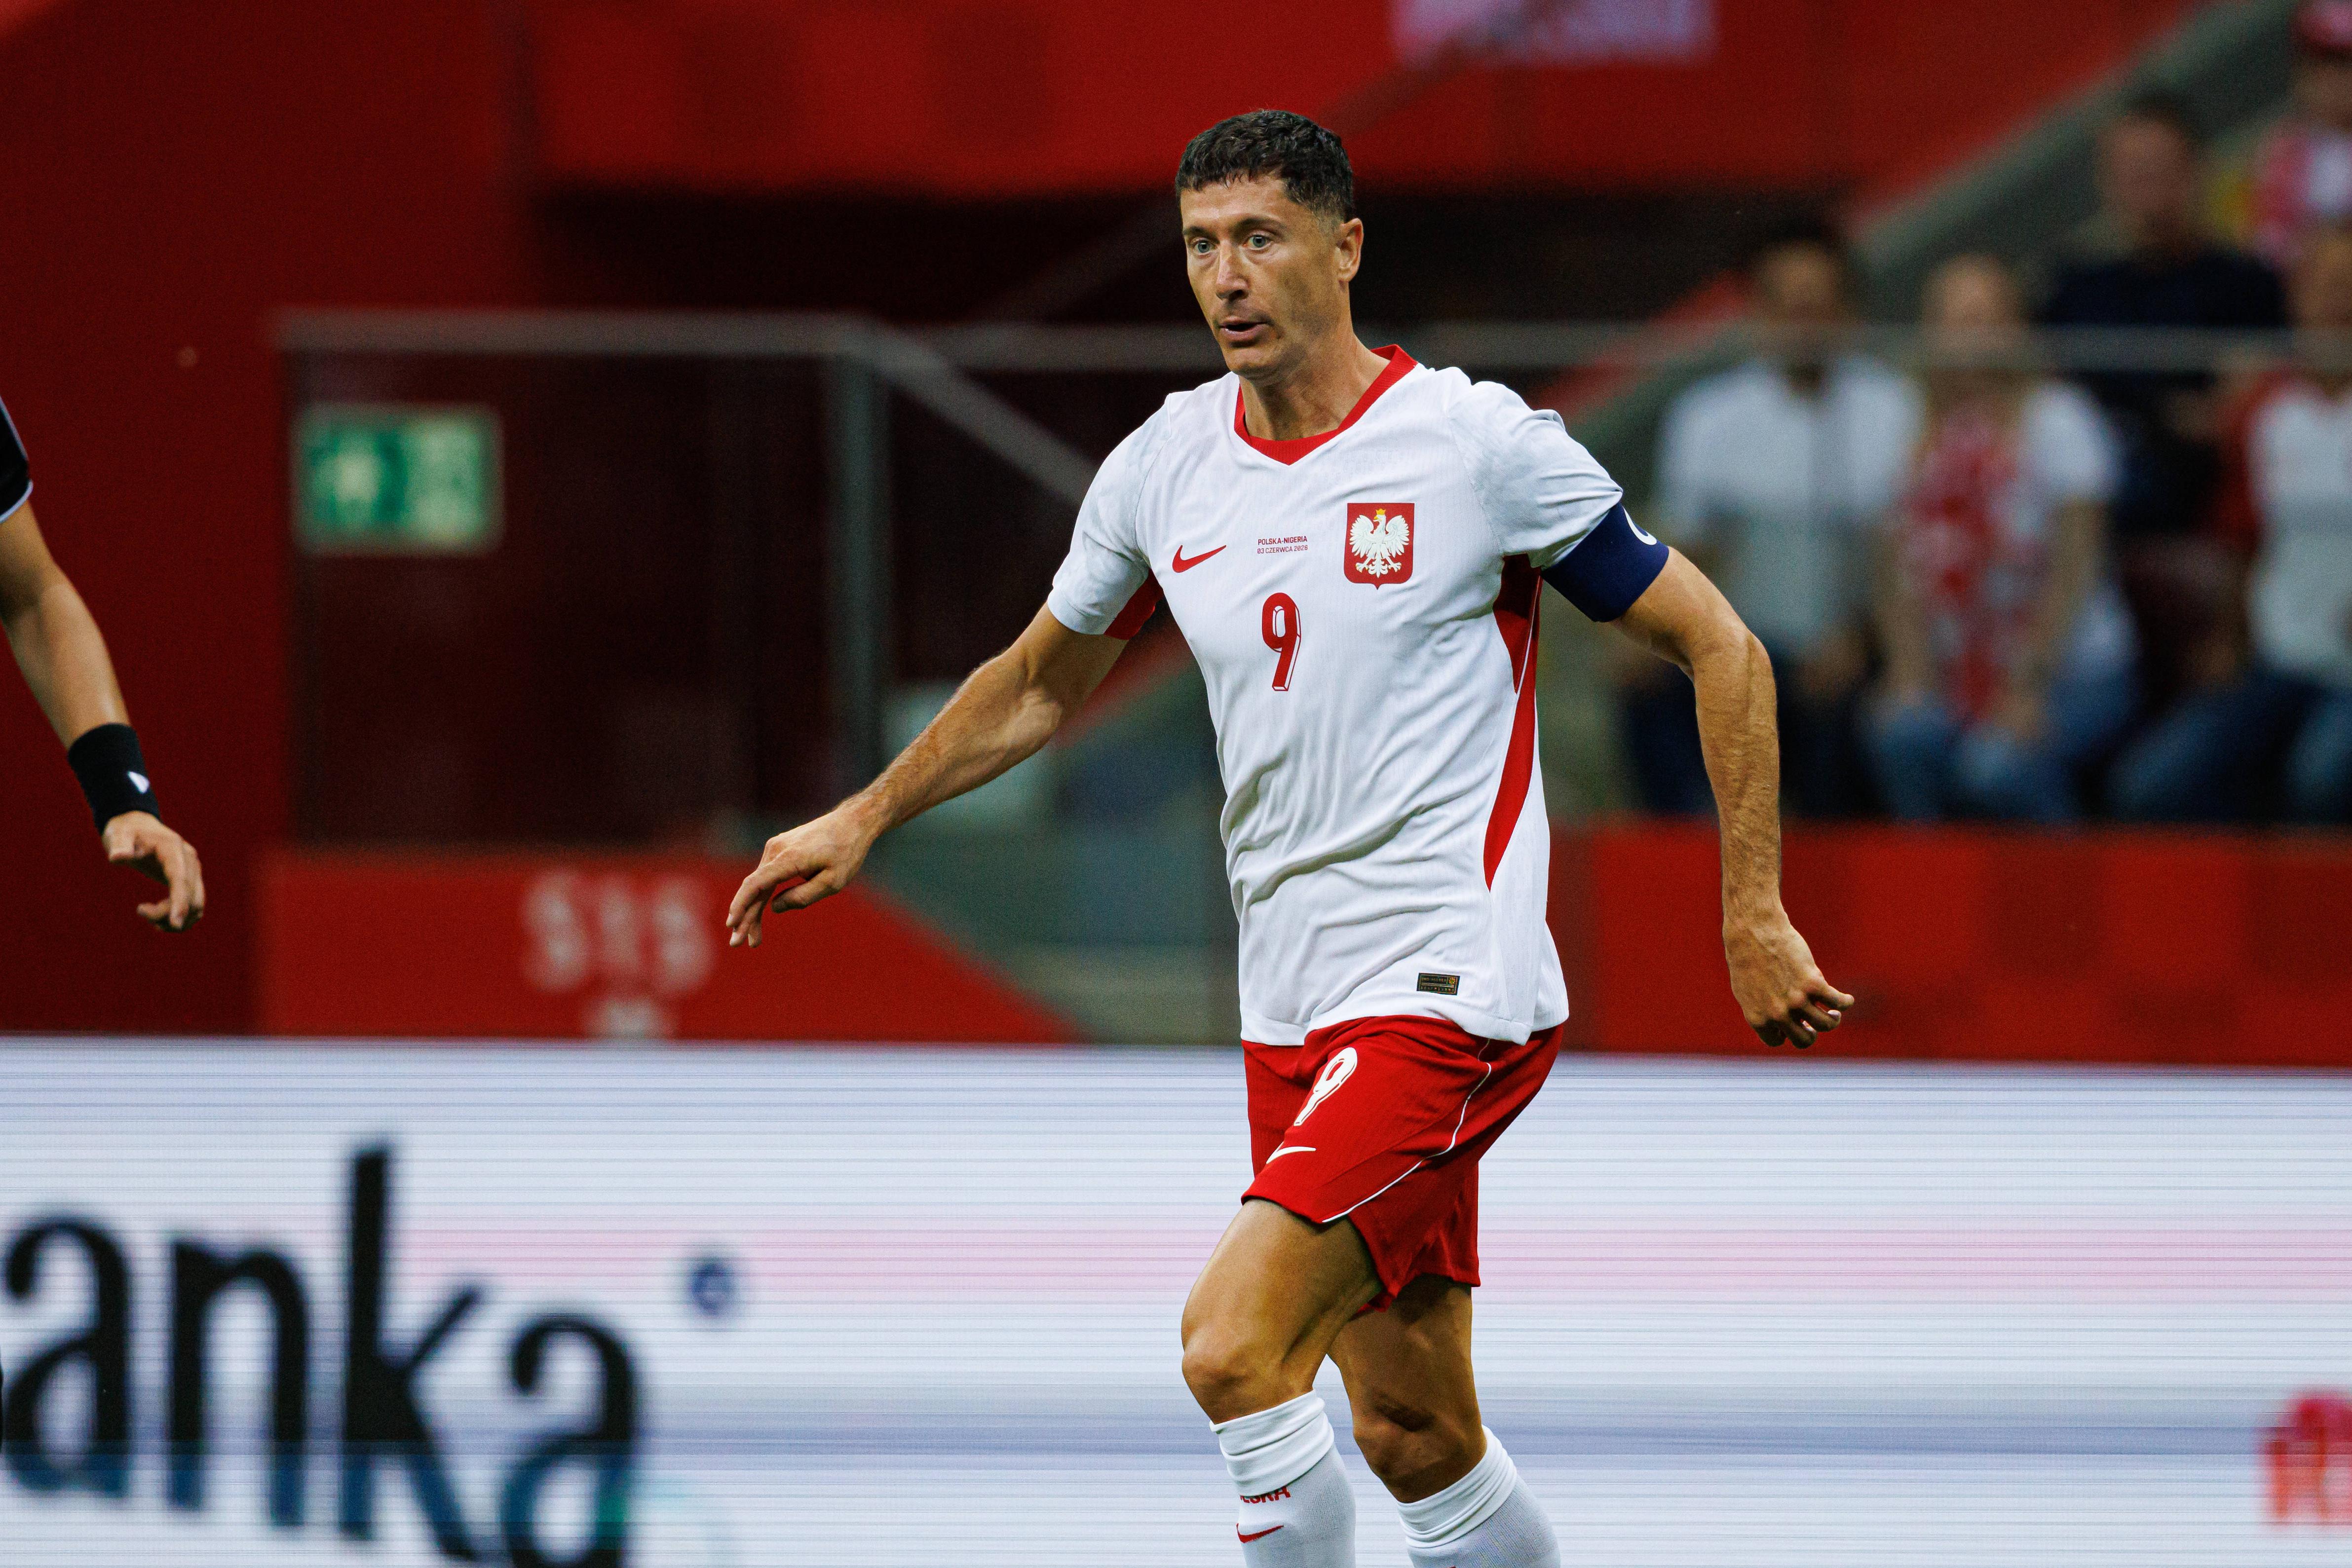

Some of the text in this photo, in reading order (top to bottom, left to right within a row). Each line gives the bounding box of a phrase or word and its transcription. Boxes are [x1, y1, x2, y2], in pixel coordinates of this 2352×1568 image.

[1258, 536, 1307, 545] POLSKA-NIGERIA
[1261, 592, 1301, 691] 9
[1293, 1047, 1358, 1126] 9
